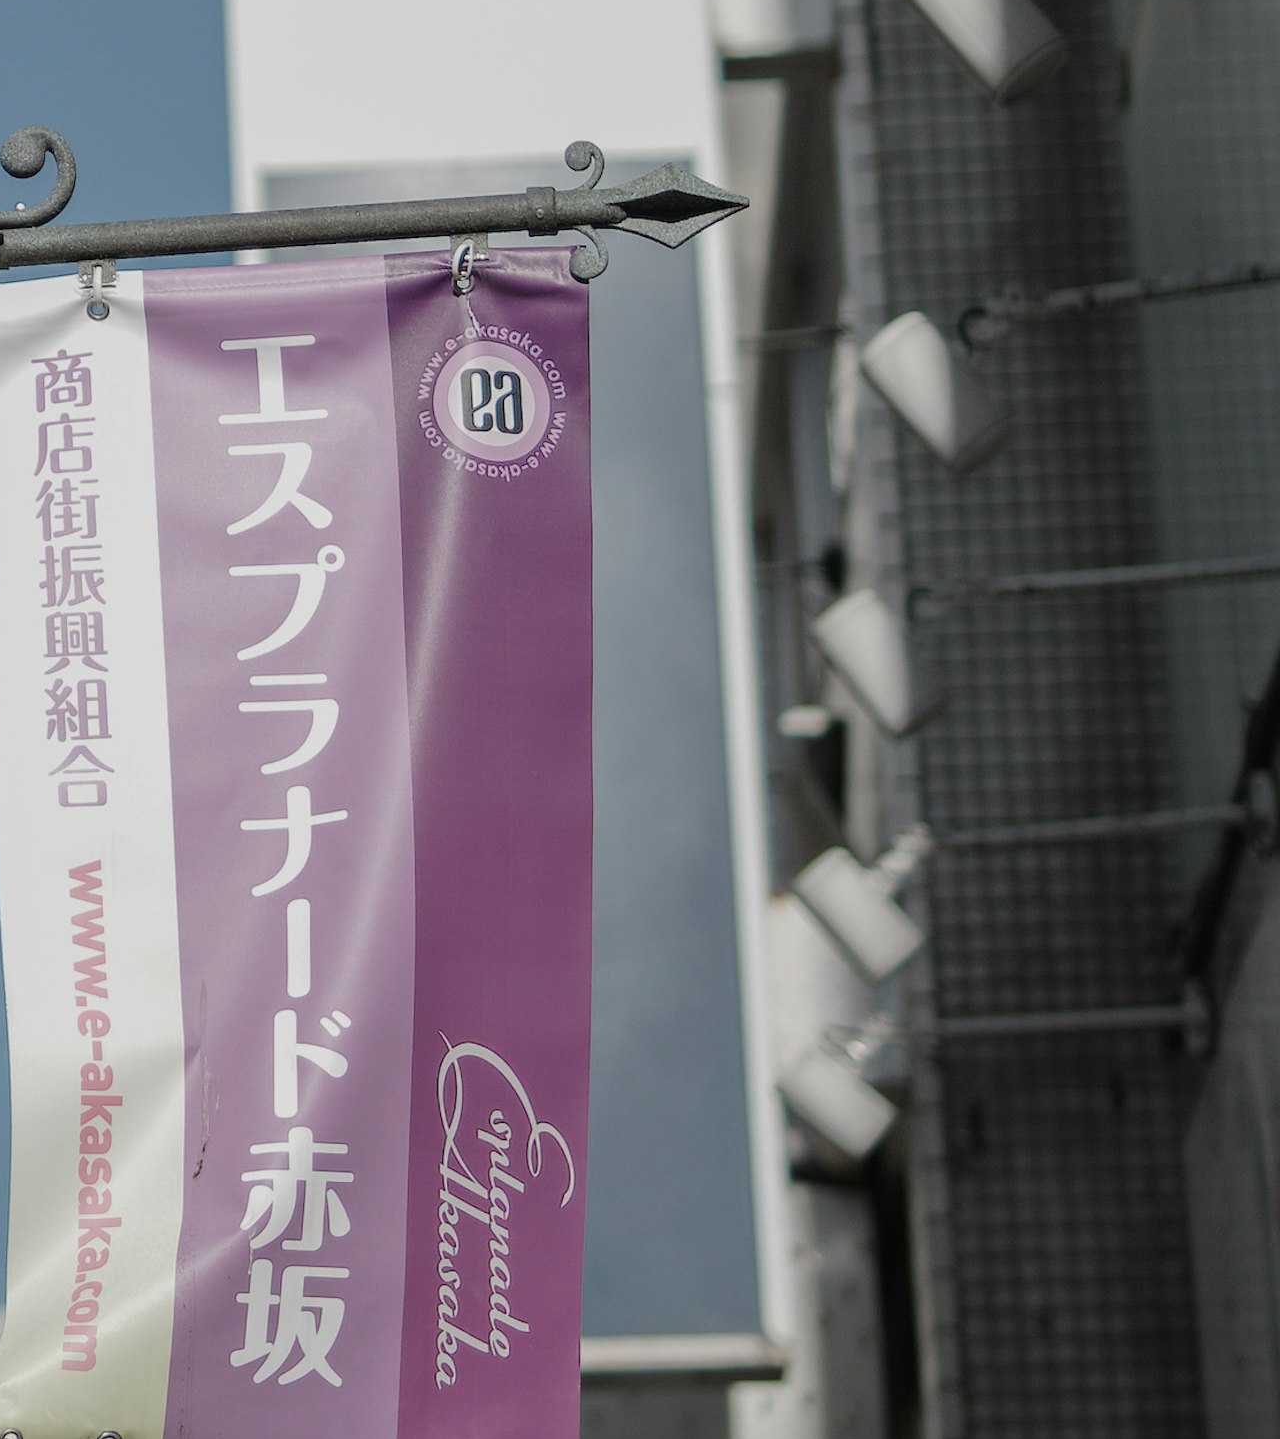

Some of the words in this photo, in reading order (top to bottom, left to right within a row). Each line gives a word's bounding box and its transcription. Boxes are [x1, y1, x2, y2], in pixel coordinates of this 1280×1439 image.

[31, 349, 116, 808] 商店街振興組合
[61, 859, 123, 1372] www.e-akasaka.com
[218, 334, 352, 1388] エスプラナード赤坂
